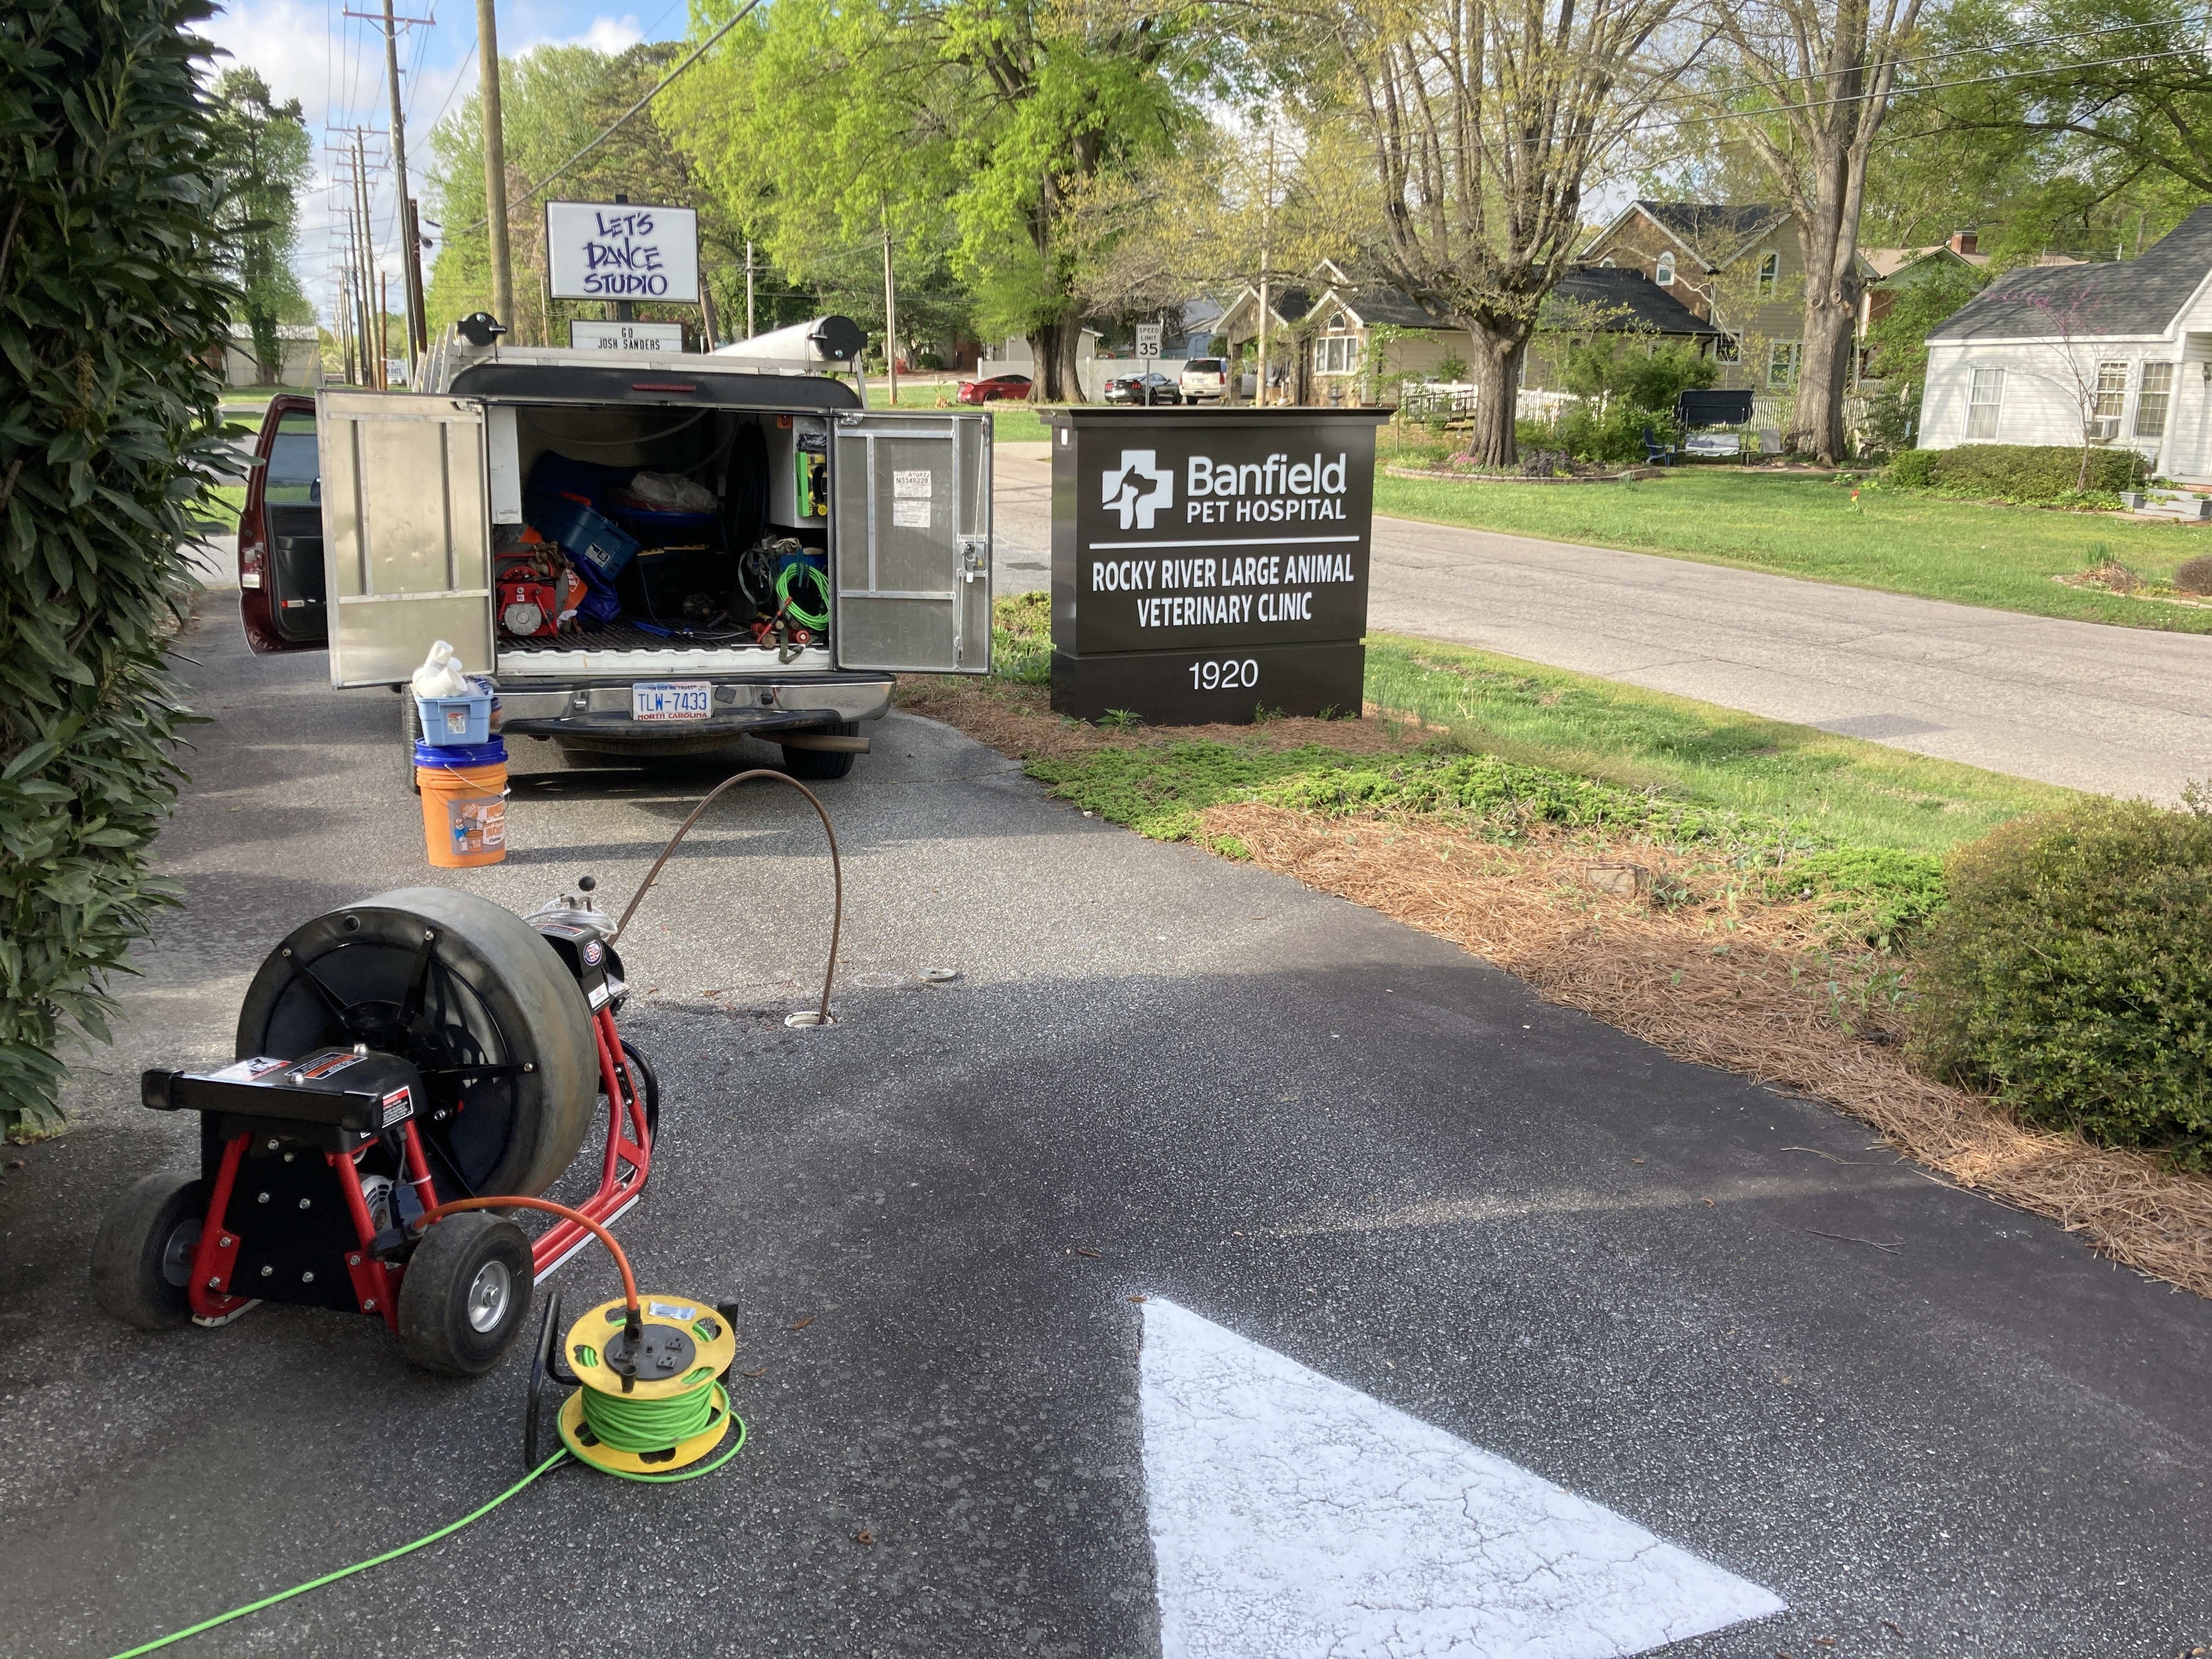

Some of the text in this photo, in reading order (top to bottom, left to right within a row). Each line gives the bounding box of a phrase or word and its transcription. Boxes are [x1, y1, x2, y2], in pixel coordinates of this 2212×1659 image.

[595, 212, 654, 238] LET'S
[582, 237, 663, 272] DANCE
[583, 273, 668, 296] STUDIO
[598, 338, 660, 351] JOSH SANDERS
[622, 328, 633, 338] GO
[1140, 343, 1158, 356] 35
[1187, 453, 1347, 496] Banfield
[1187, 498, 1347, 523] PET HOSPITAL
[1092, 554, 1355, 591] ROCKY RIVER LARGE ANIMAL
[1137, 592, 1313, 628] VETERINARY CLINIC
[1188, 659, 1259, 690] 1920
[638, 692, 707, 712] TLW-7433
